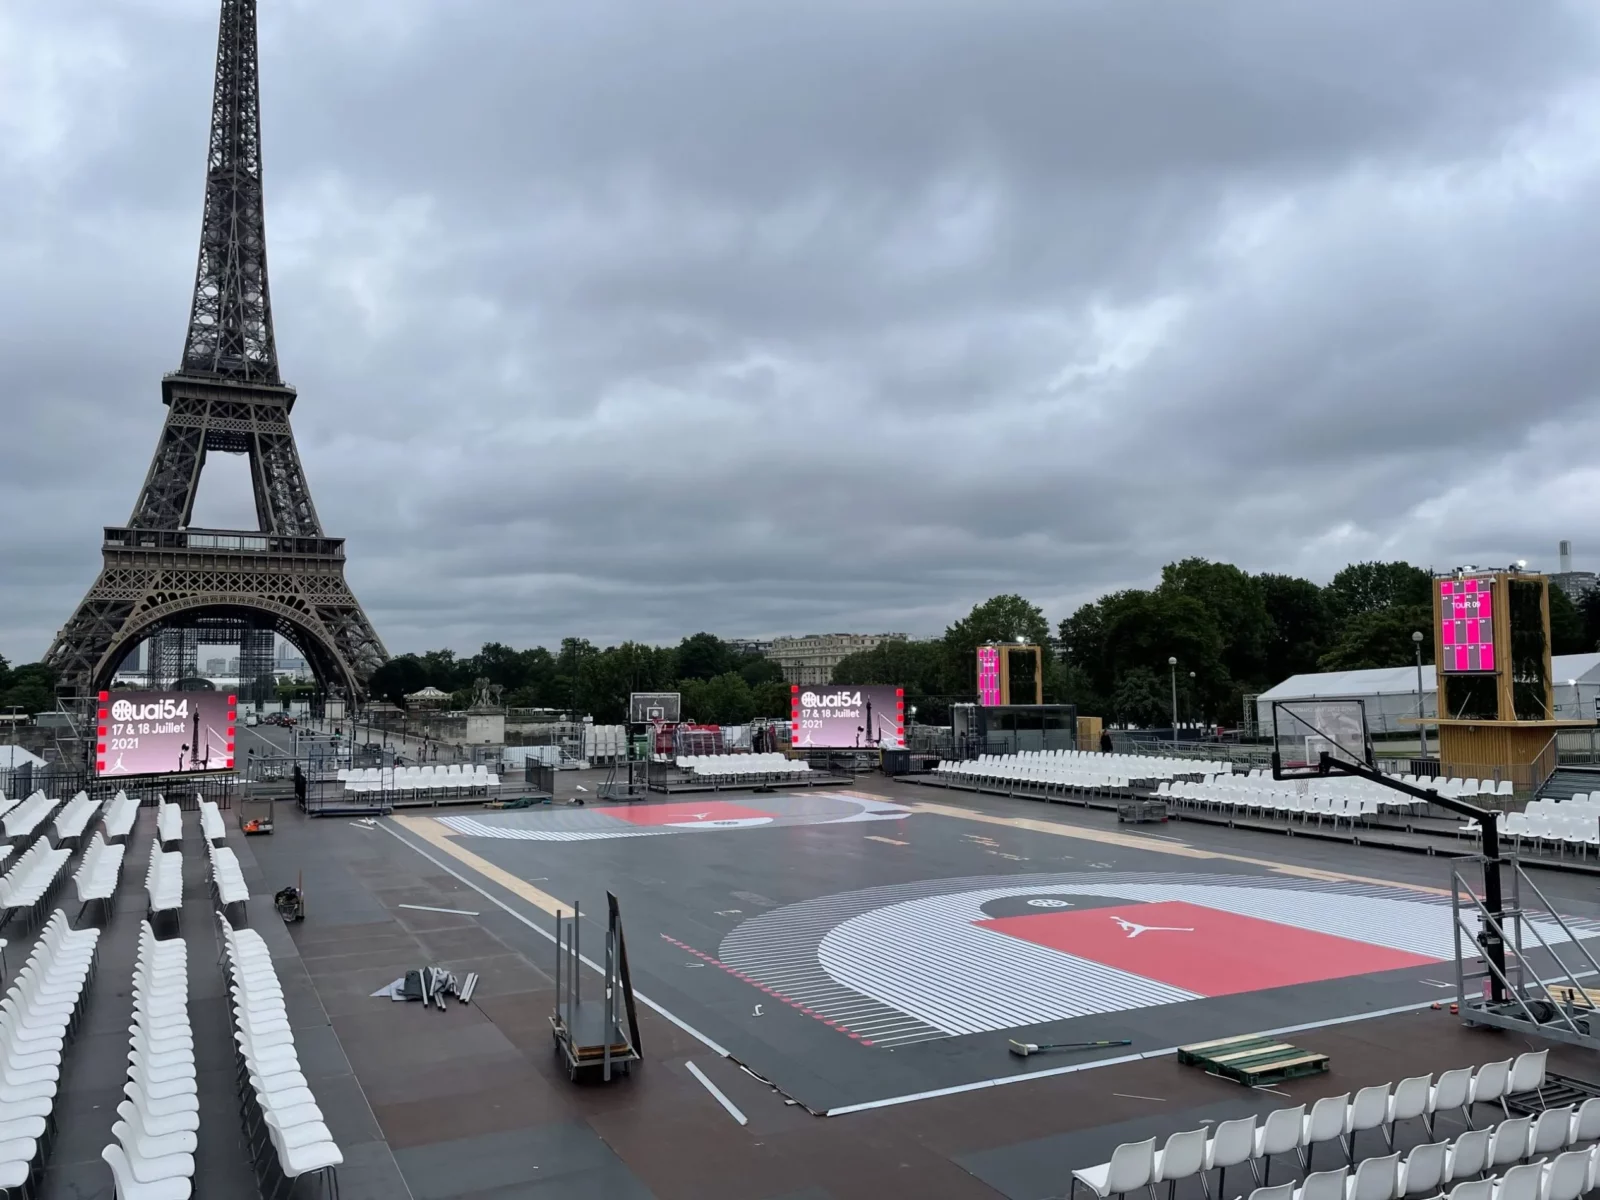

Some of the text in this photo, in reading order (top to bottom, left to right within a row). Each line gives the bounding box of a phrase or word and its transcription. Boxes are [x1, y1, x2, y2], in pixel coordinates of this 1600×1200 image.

[1451, 600, 1481, 609] TOUR 09
[801, 691, 862, 708] Quai54
[112, 699, 188, 721] Quai54
[802, 709, 860, 718] 17 & 18 Juillet
[112, 722, 185, 735] 17 & 18 Juillet
[802, 720, 822, 728] 2021
[111, 738, 138, 750] 2021
